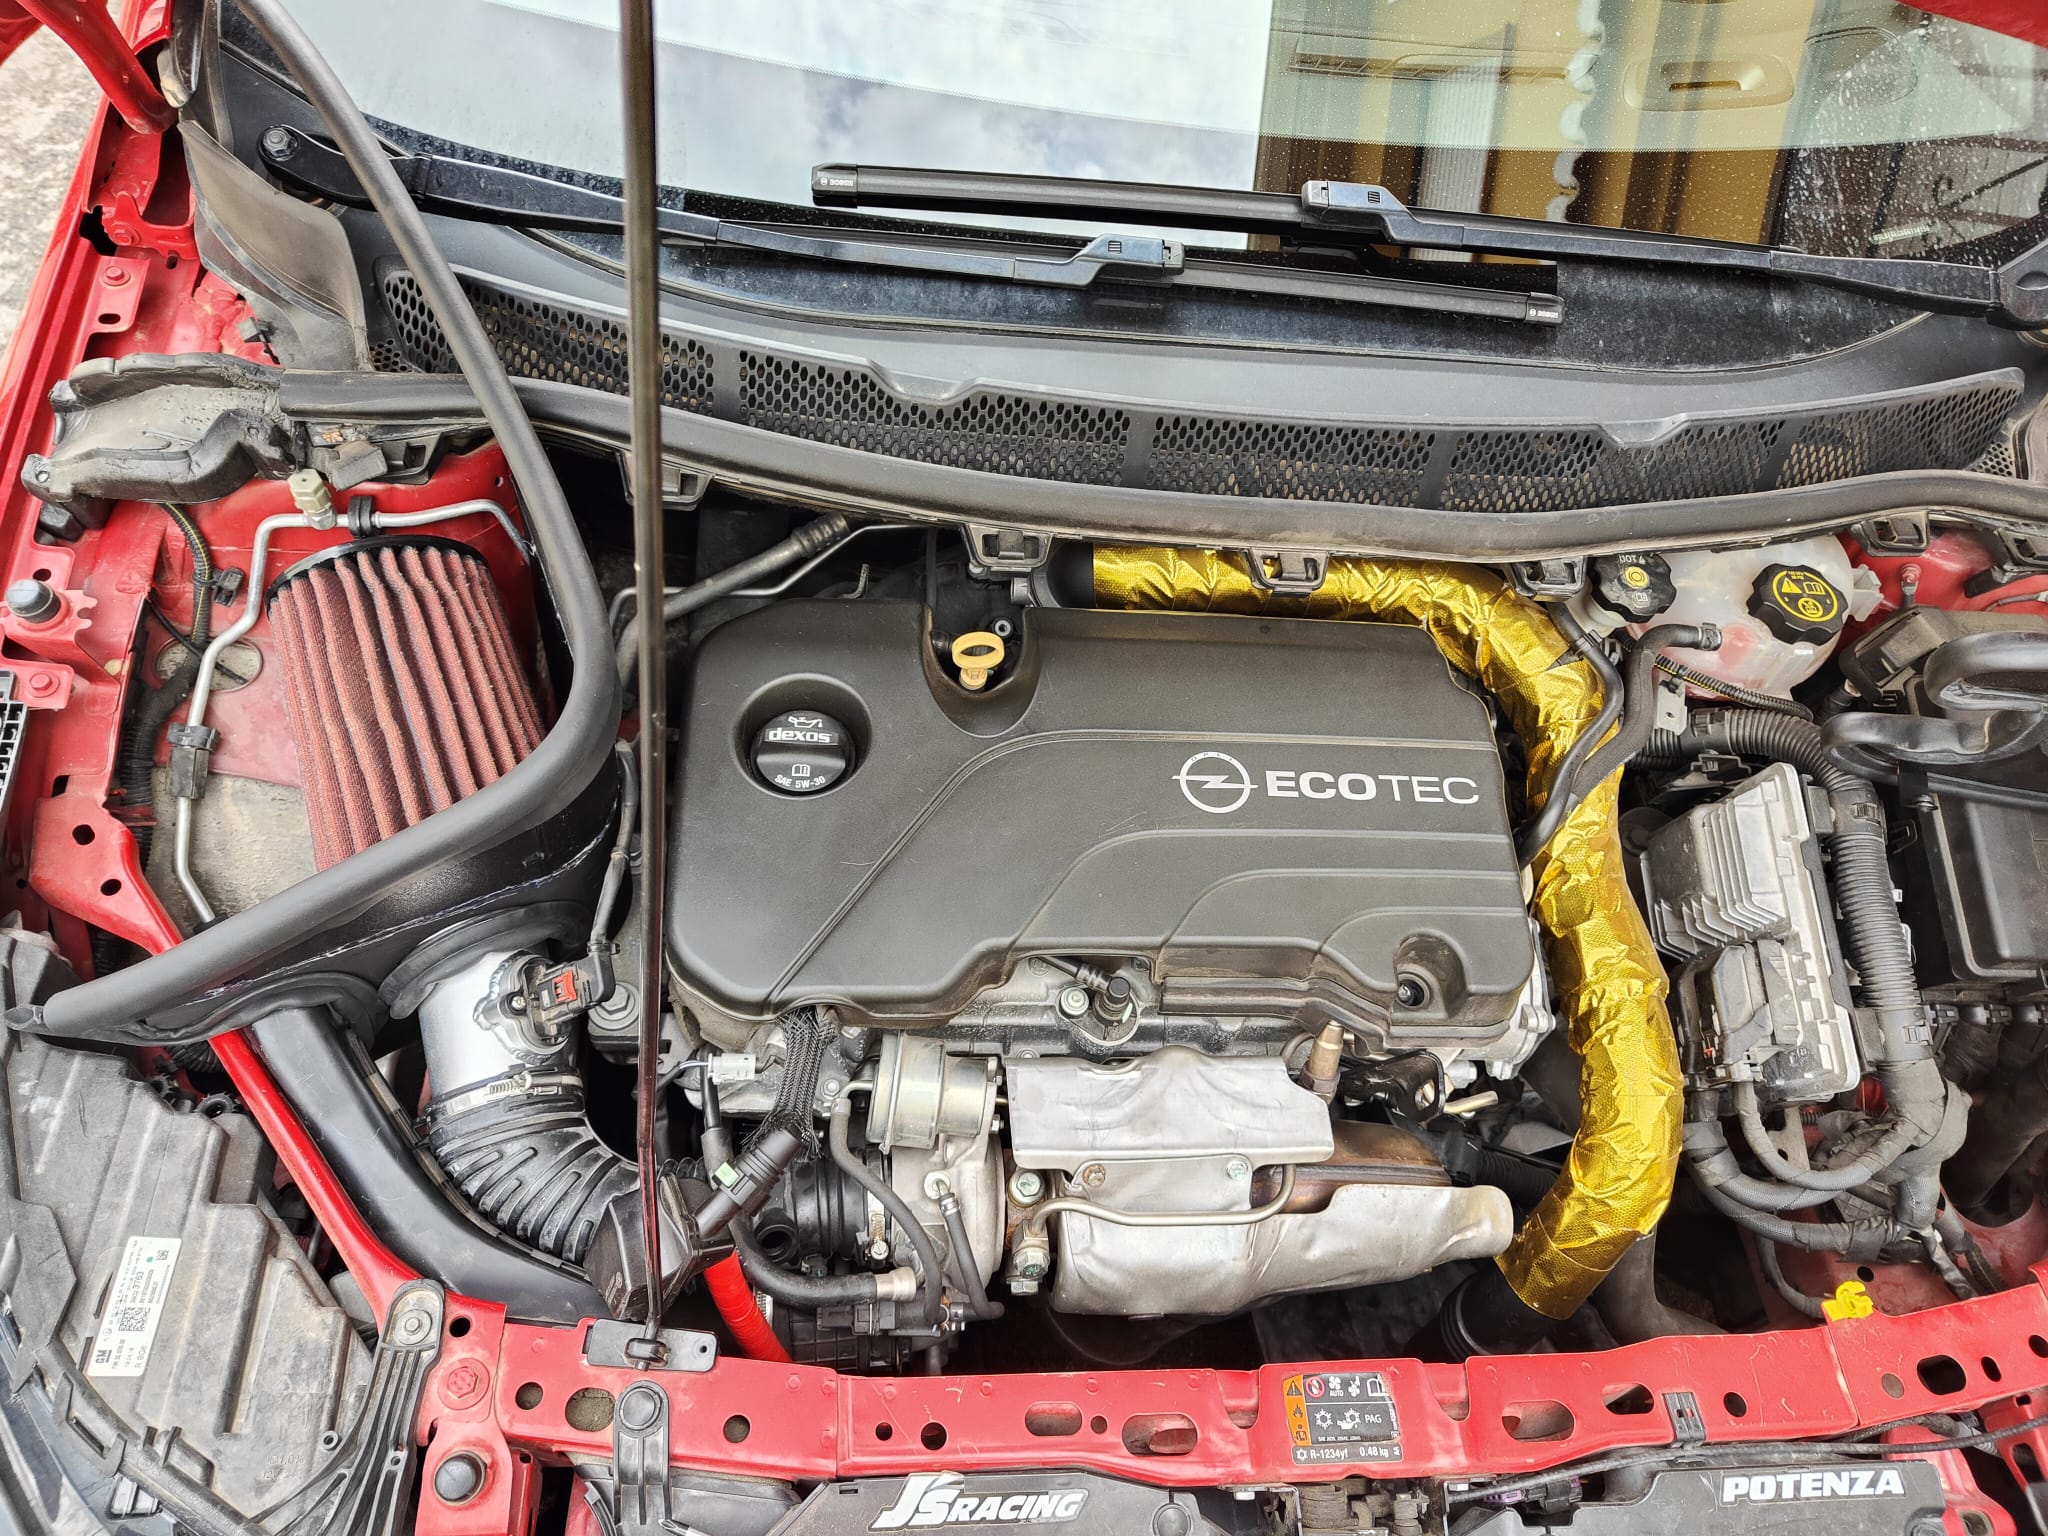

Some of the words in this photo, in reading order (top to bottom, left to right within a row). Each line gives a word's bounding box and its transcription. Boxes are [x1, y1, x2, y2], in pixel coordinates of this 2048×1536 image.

[768, 727, 833, 743] dexos
[774, 774, 793, 787] SAE
[795, 775, 826, 789] 5W-30
[1265, 770, 1480, 805] ECOTEC
[95, 1349, 108, 1364] GM
[1329, 1389, 1344, 1397] AUTO
[1364, 1414, 1383, 1424] PAG
[1310, 1447, 1349, 1460] R-1234yf
[1359, 1446, 1378, 1457] 0.48
[1379, 1446, 1389, 1458] kg
[1722, 1469, 1905, 1503] POTENZA
[945, 1492, 1084, 1523] RACING
